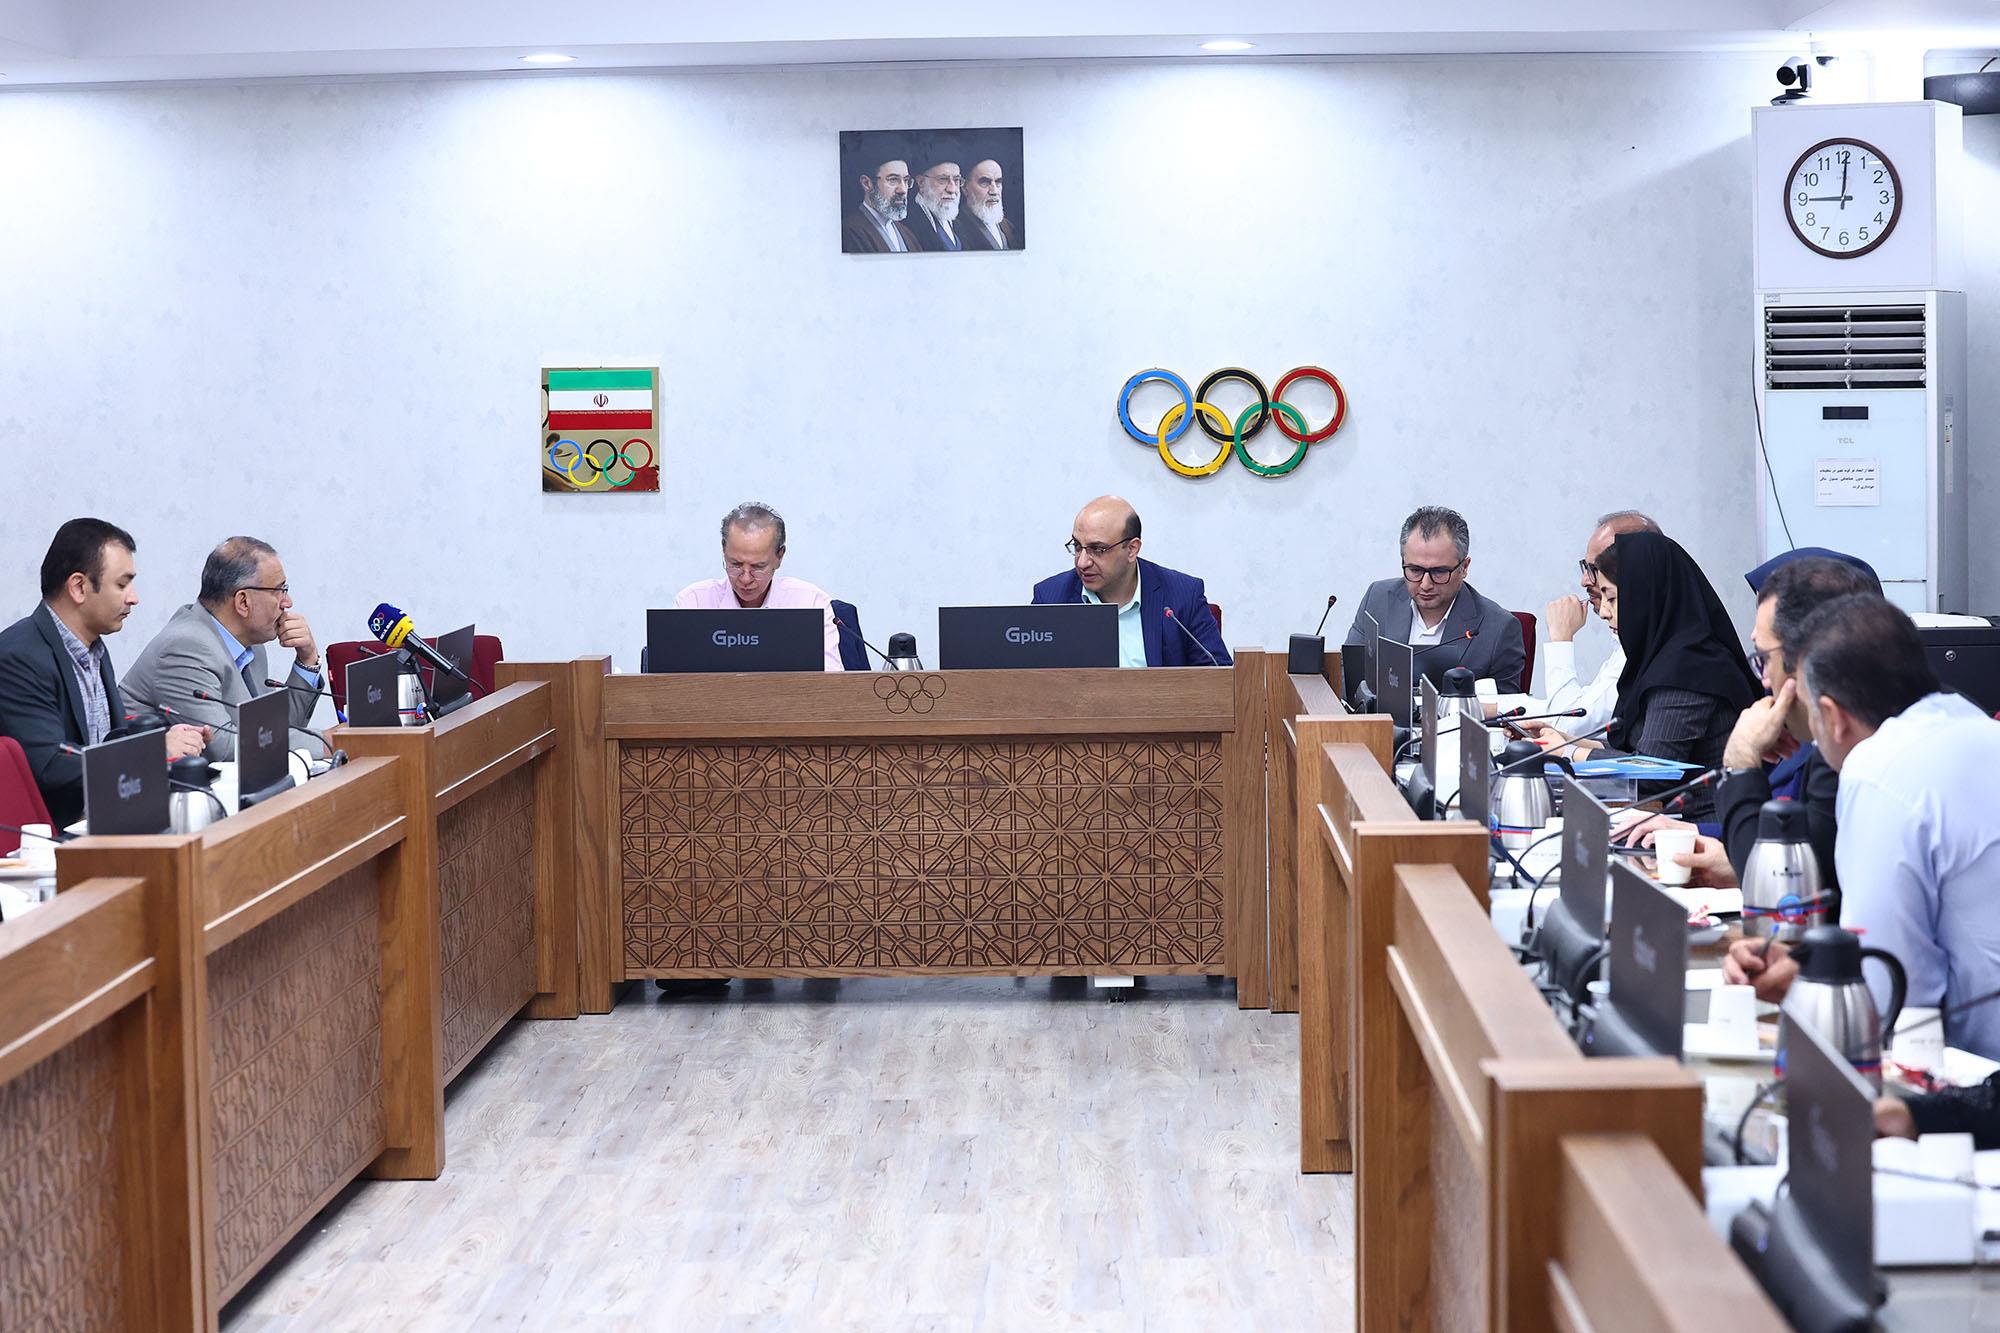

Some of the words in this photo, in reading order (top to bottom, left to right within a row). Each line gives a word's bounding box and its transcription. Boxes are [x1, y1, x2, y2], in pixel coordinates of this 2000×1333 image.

[1817, 157, 1830, 171] 11
[1835, 150, 1851, 165] 12
[1860, 156, 1866, 170] 1
[1803, 173, 1819, 187] 10
[1873, 170, 1884, 184] 2
[1797, 192, 1808, 207] 9
[1879, 190, 1890, 204] 3
[1805, 212, 1816, 226] 8
[1873, 211, 1884, 225] 4
[1820, 227, 1830, 241] 7
[1838, 231, 1850, 246] 6
[1858, 227, 1869, 241] 5
[712, 629, 760, 648] Gplus
[1005, 626, 1053, 645] Gplus
